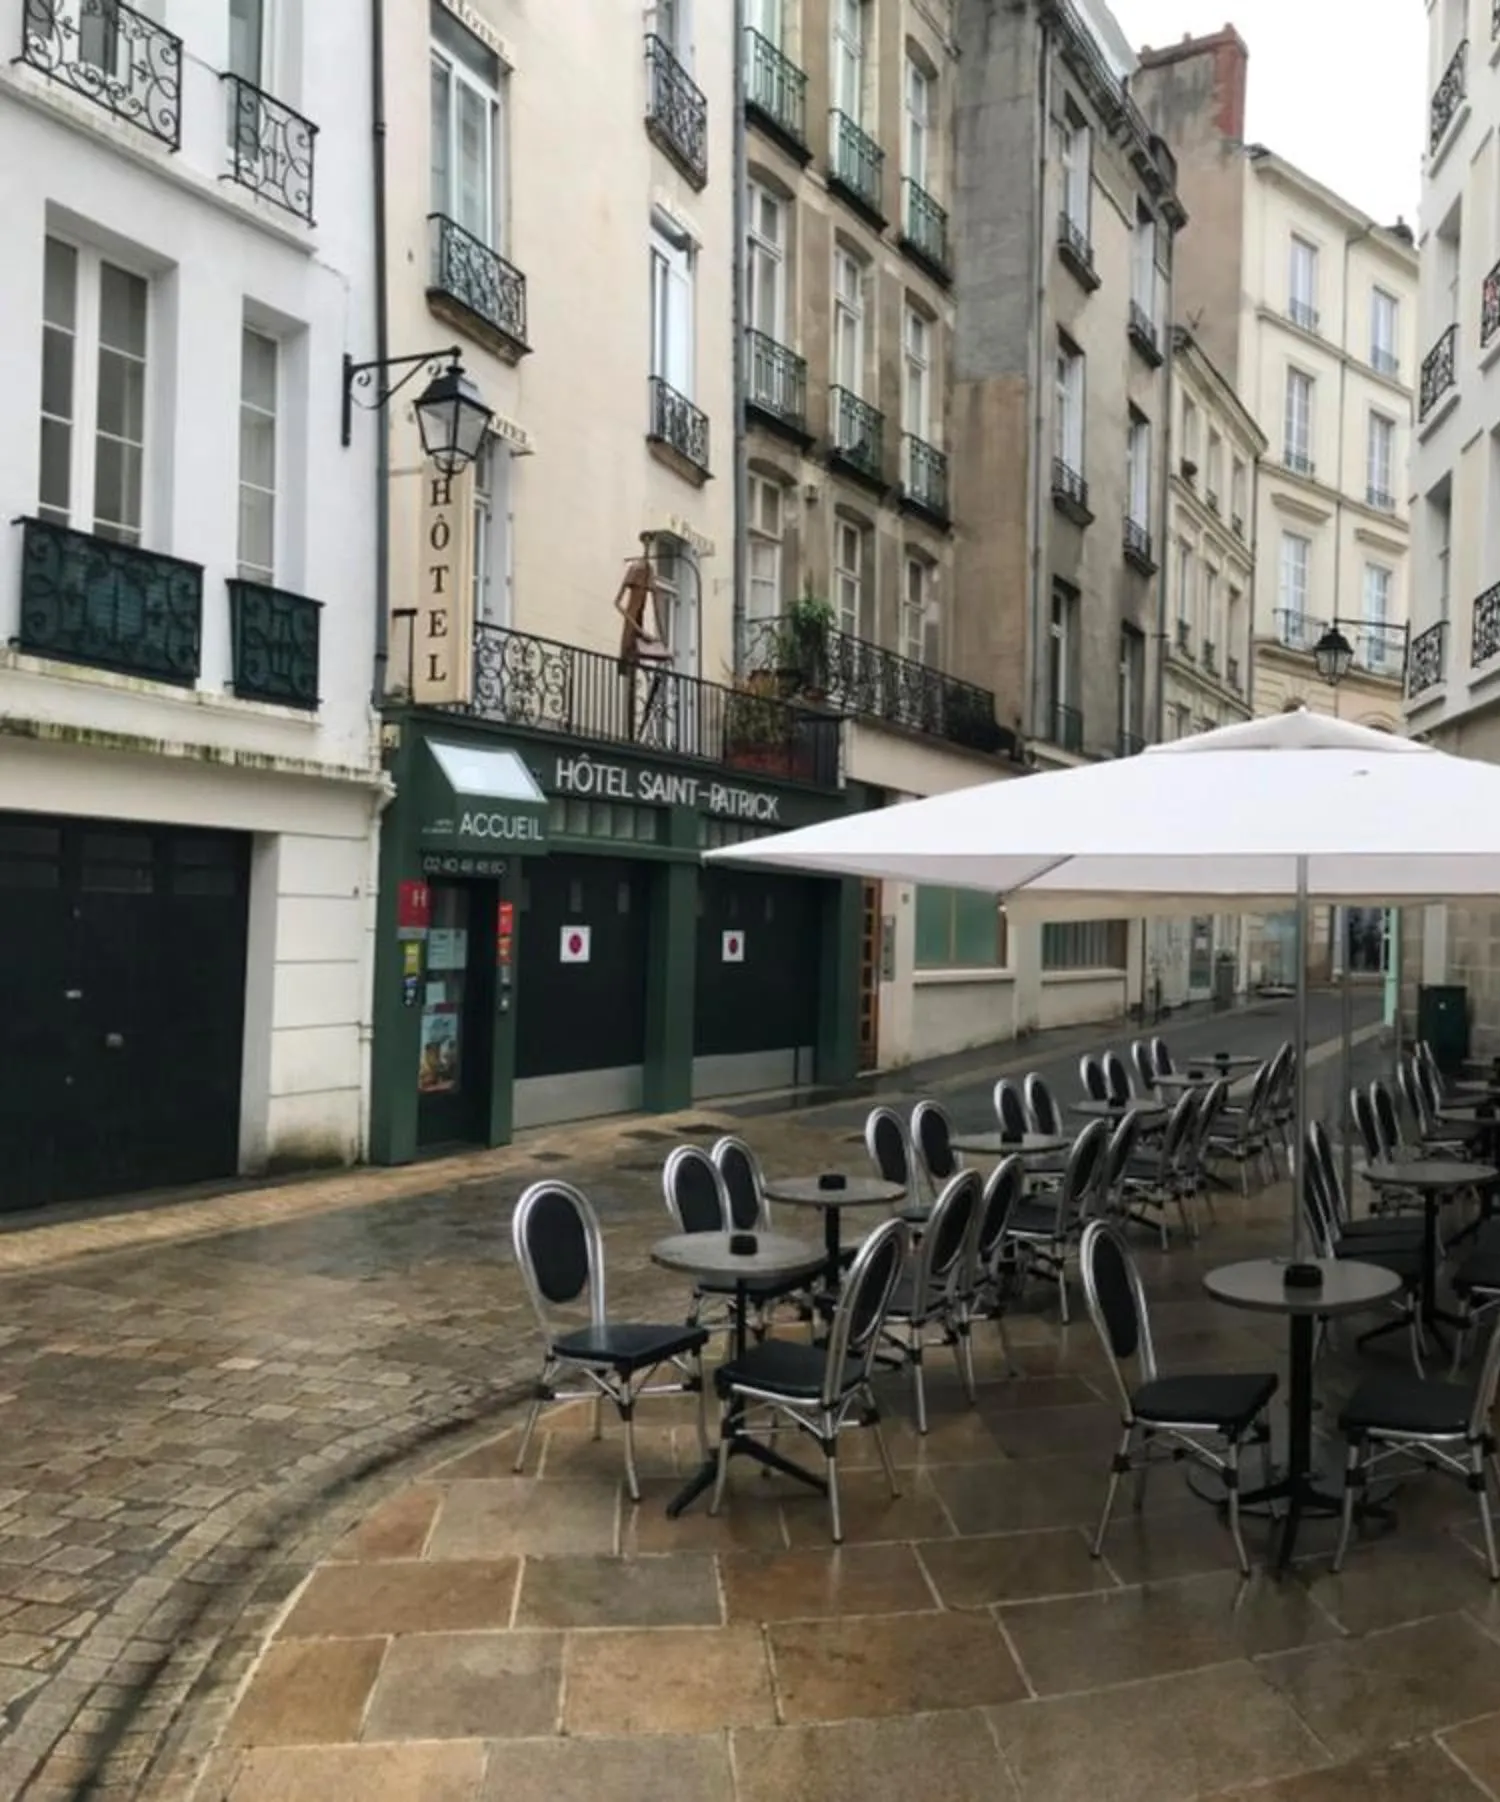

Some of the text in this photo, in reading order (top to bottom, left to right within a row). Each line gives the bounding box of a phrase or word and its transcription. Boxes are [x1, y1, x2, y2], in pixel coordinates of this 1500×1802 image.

[427, 478, 452, 682] HÔTEL
[556, 753, 634, 798] HÔTEL
[459, 811, 544, 841] ACCUEIL
